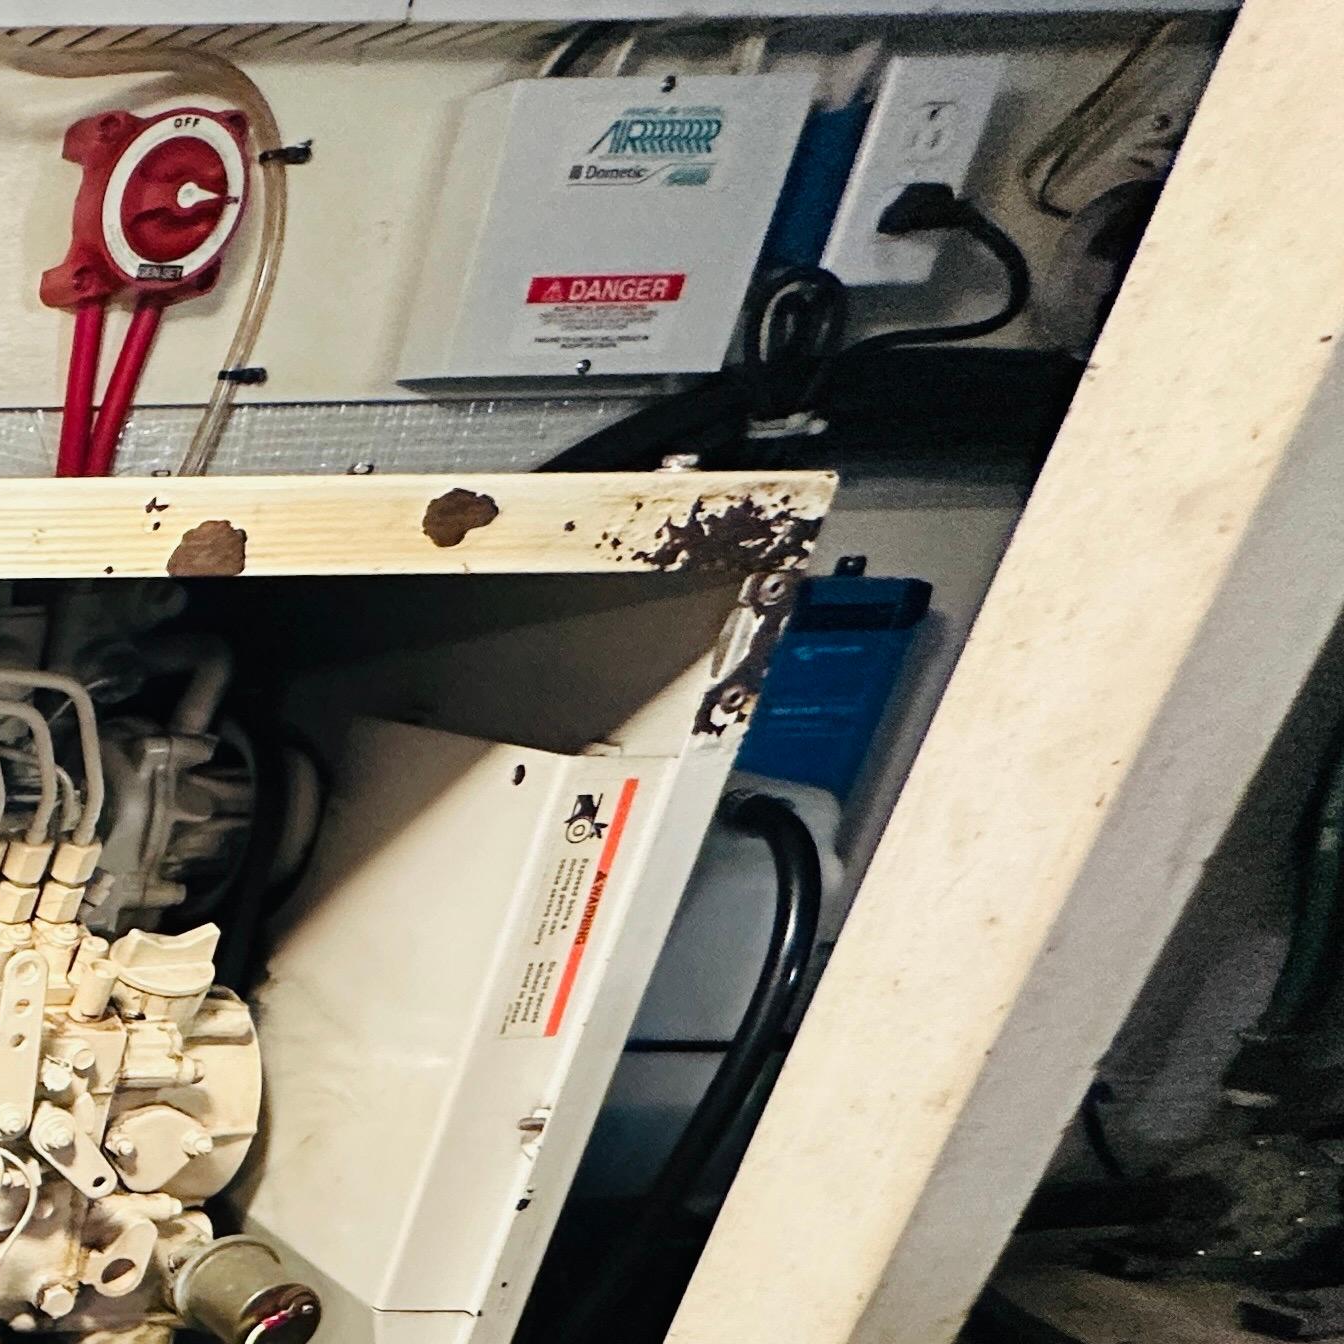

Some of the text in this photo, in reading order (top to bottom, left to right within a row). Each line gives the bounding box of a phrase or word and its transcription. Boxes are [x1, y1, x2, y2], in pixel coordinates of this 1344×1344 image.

[174, 118, 200, 128] OFF
[586, 165, 647, 179] Dometic
[568, 279, 669, 300] DANGER
[574, 883, 604, 945] WARNING
